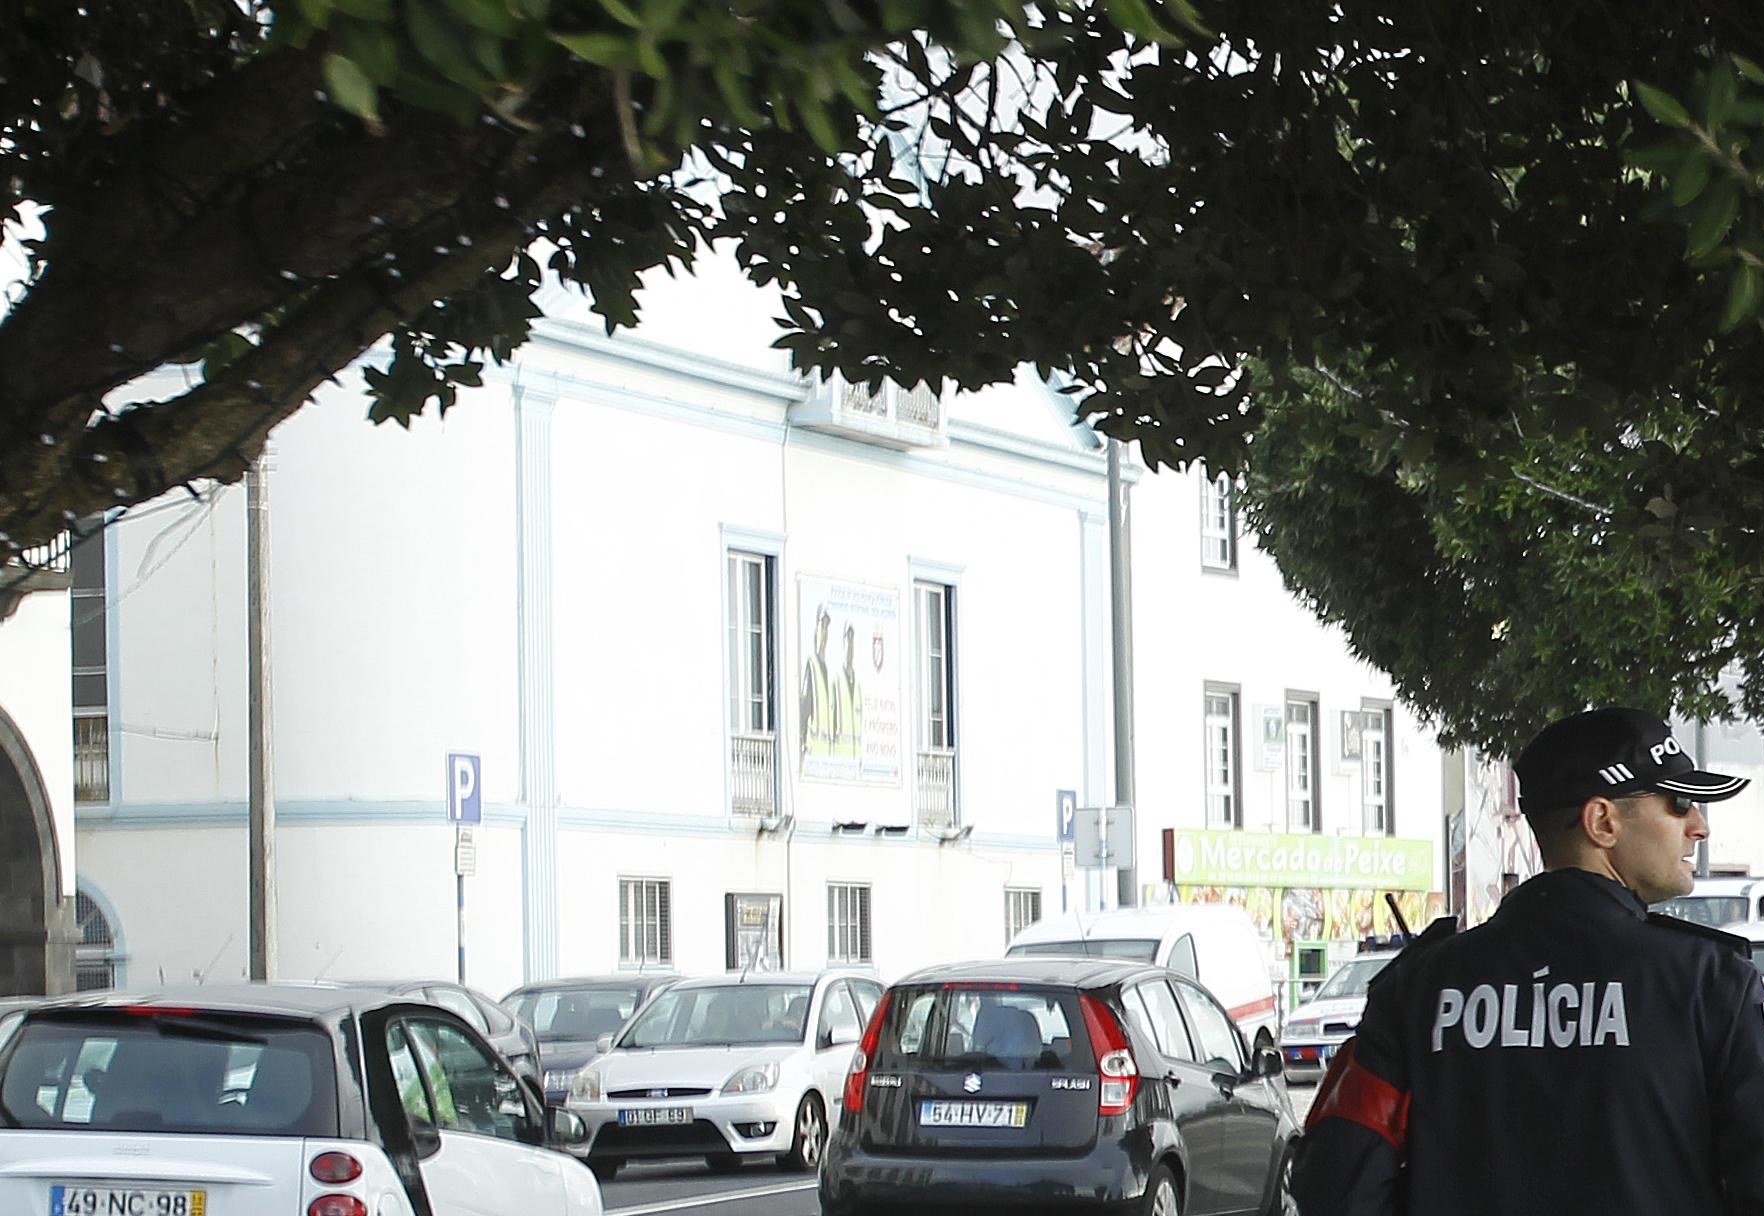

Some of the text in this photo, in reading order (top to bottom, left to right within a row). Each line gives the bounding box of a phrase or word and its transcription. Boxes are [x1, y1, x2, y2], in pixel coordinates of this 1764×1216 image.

[454, 756, 476, 820] P
[1063, 798, 1073, 835] P
[1200, 837, 1322, 872] Mercado
[1345, 843, 1406, 875] Peixe
[1432, 965, 1630, 1051] POLÍCIA
